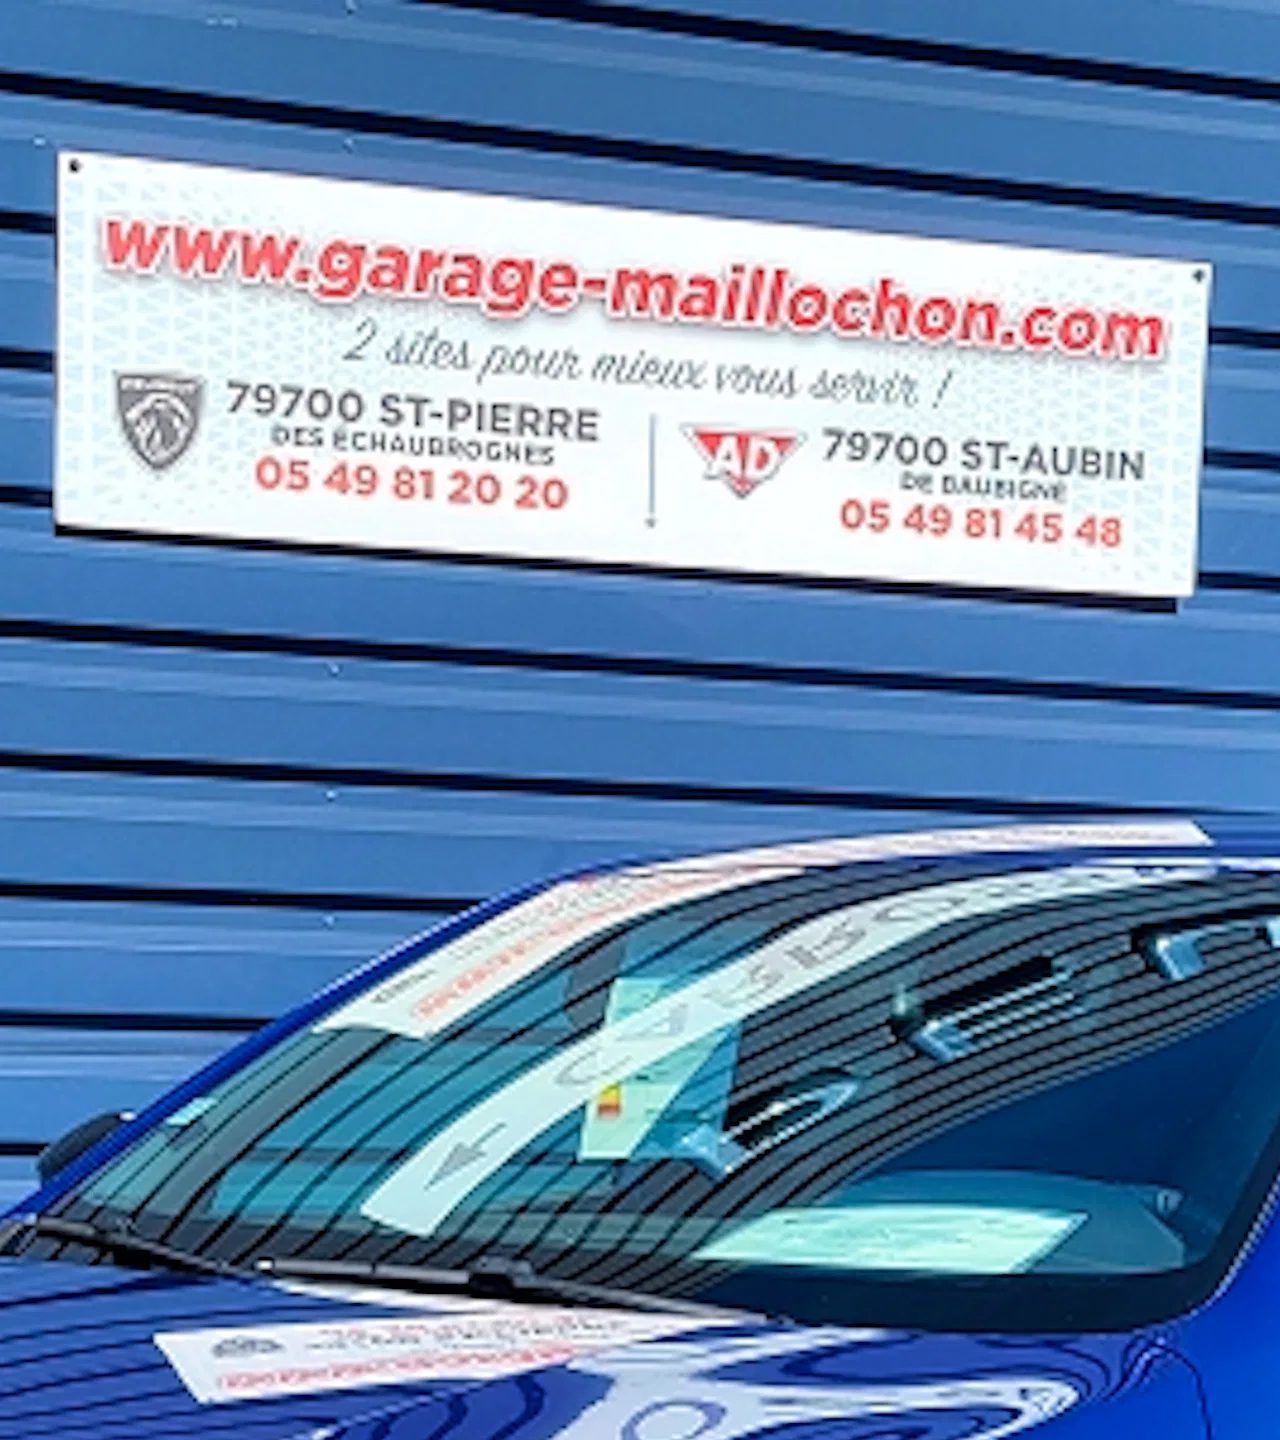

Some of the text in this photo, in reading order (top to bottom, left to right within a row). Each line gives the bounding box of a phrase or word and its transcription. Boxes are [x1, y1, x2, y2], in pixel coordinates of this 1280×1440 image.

[105, 217, 1167, 357] www.garage-maillochon.com
[343, 318, 378, 362] 2
[384, 328, 474, 372] sites
[477, 341, 578, 384] pour
[592, 349, 707, 390] mieux
[716, 362, 799, 400] vous
[809, 368, 921, 407] servir
[226, 380, 600, 443] 79700 ST-PIERRE
[270, 425, 324, 448] DES
[704, 432, 780, 479] AD
[822, 428, 1145, 480] 79700 ST-AUBIN
[255, 454, 569, 510] 05 49 81 20 20
[900, 470, 934, 494] DE
[840, 498, 1122, 548] 05 49 81 45 48
